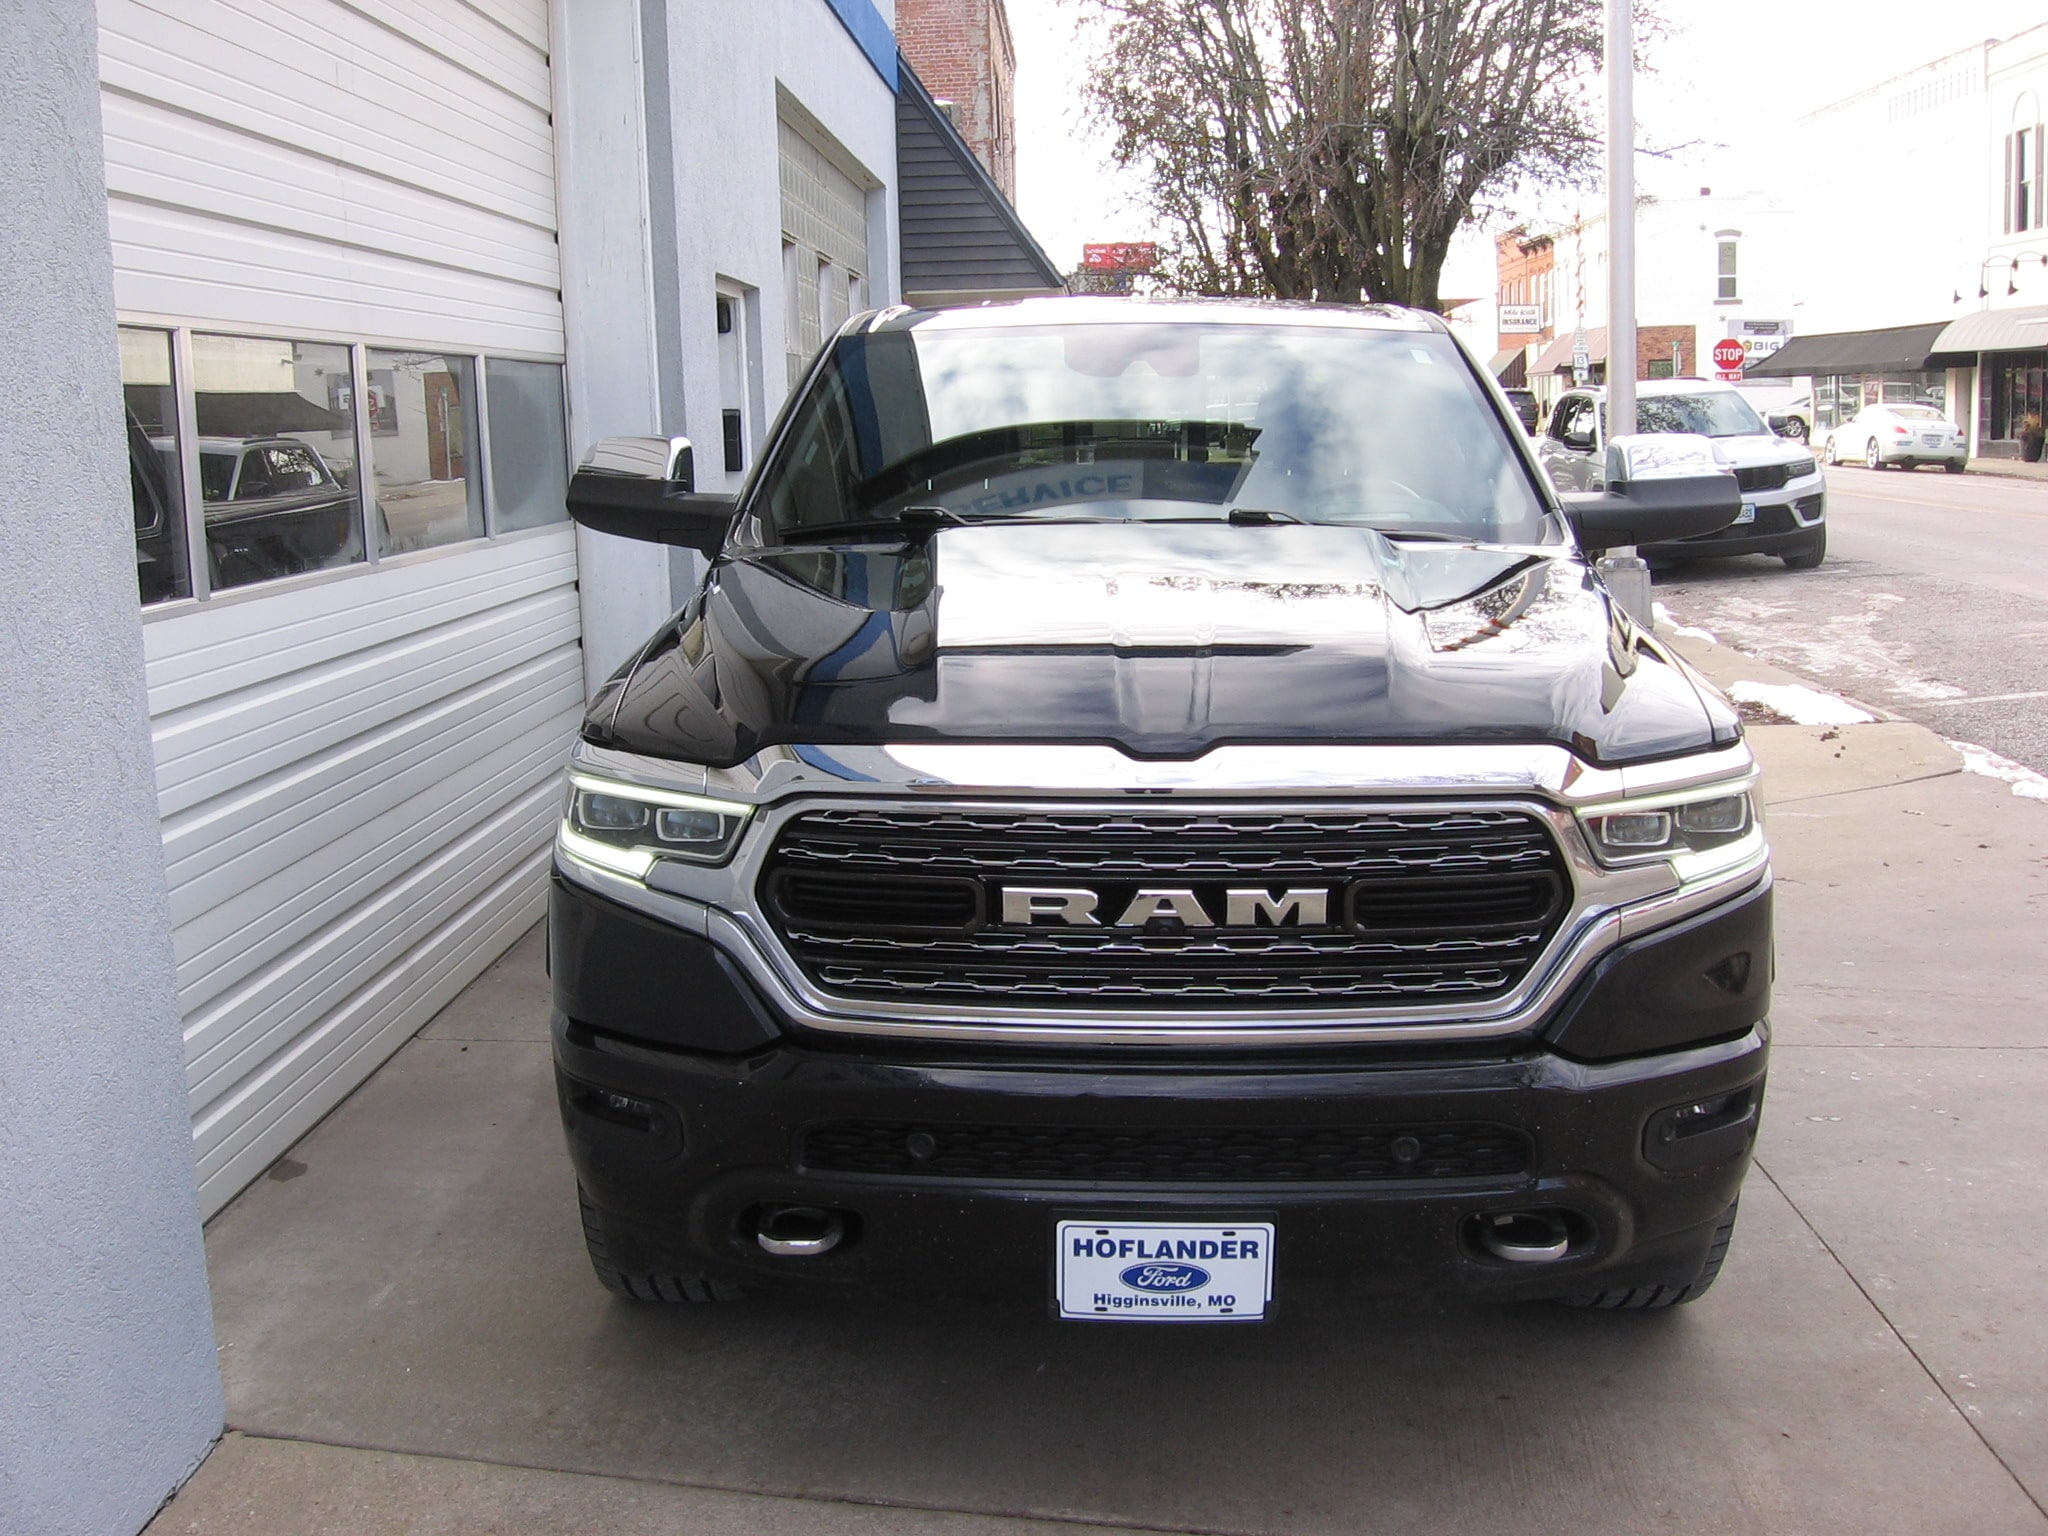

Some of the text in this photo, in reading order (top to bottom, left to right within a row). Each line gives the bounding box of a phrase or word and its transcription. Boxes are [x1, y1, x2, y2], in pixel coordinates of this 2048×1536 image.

[1714, 348, 1743, 361] STOP
[1754, 341, 1780, 350] BIG
[1002, 886, 1329, 926] RAM
[1072, 1238, 1259, 1260] HOFLANDER
[1137, 1266, 1192, 1288] Ford
[1093, 1293, 1236, 1309] Higginsville, MO
